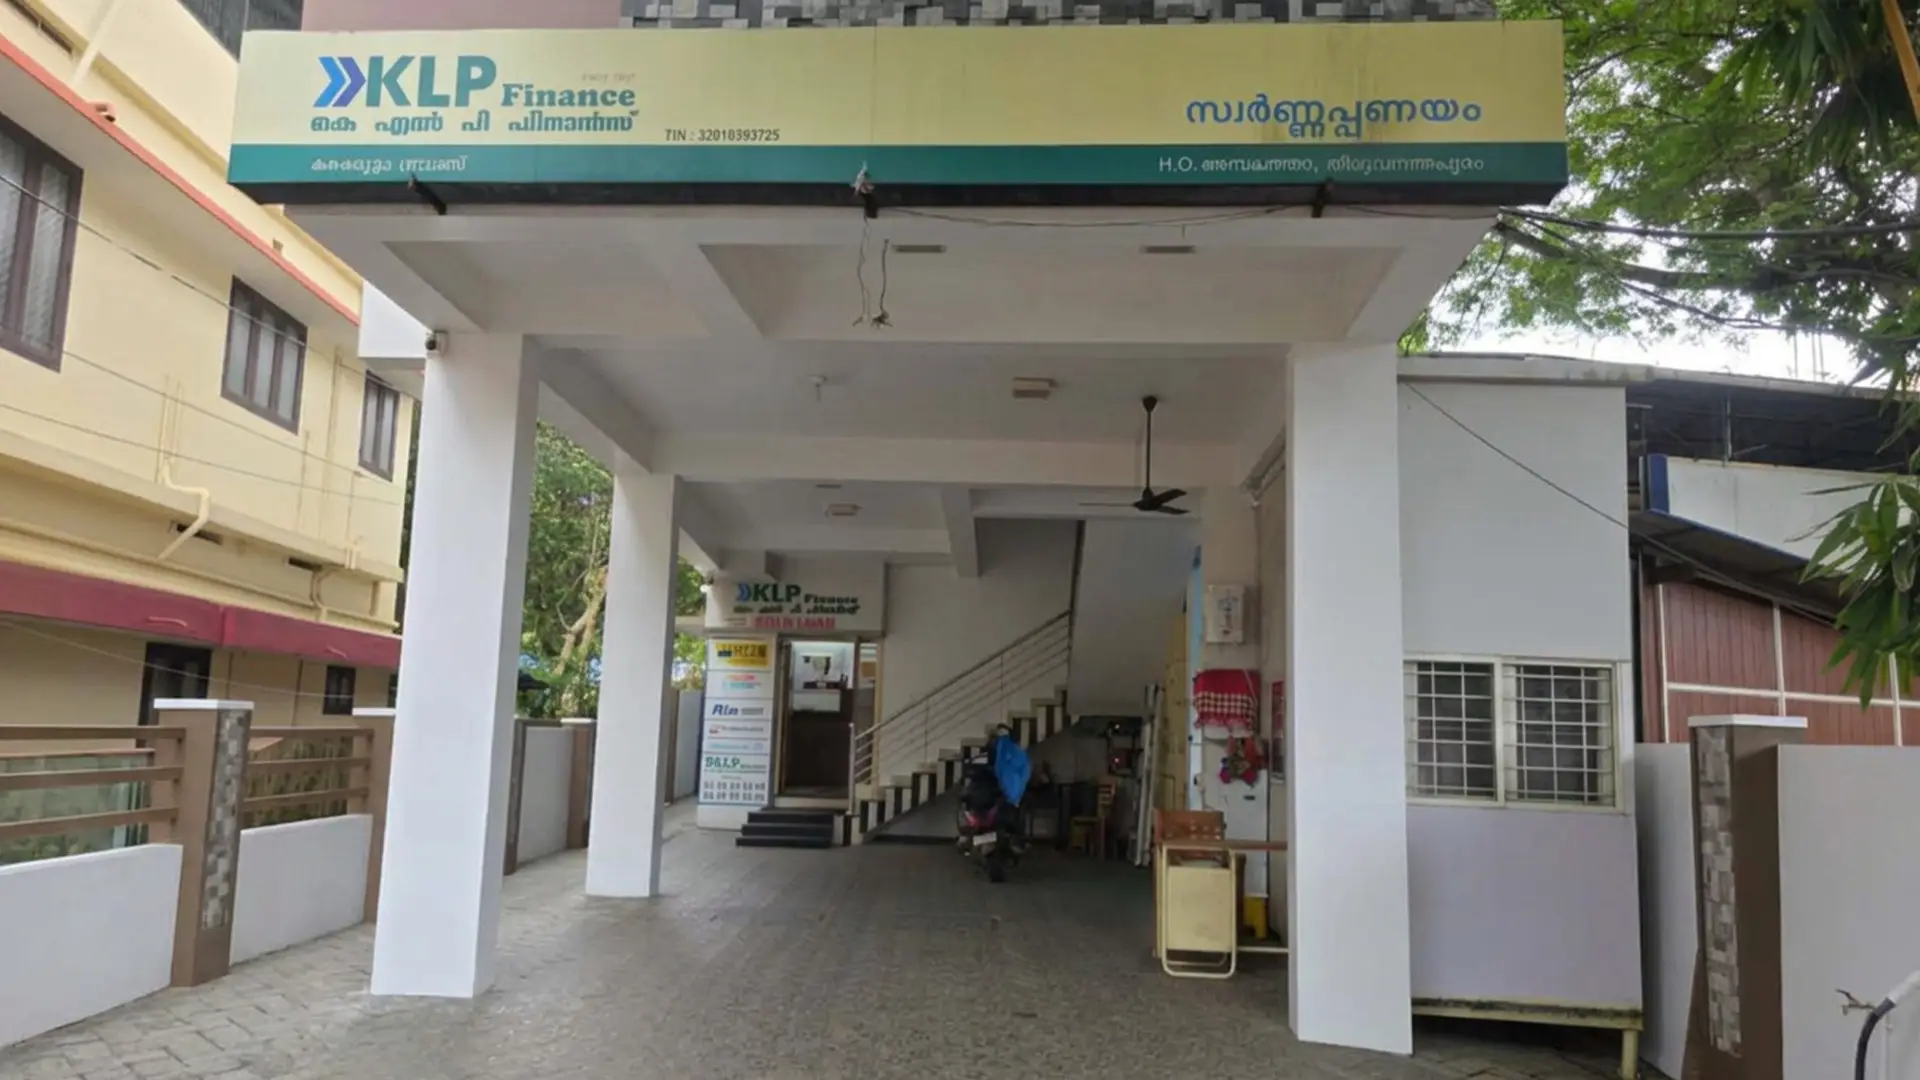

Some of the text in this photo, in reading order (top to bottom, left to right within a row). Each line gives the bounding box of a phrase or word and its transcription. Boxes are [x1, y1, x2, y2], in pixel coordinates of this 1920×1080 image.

[366, 55, 636, 107] KLP Finance
[664, 128, 686, 141] TIN
[752, 583, 802, 603] KLP
